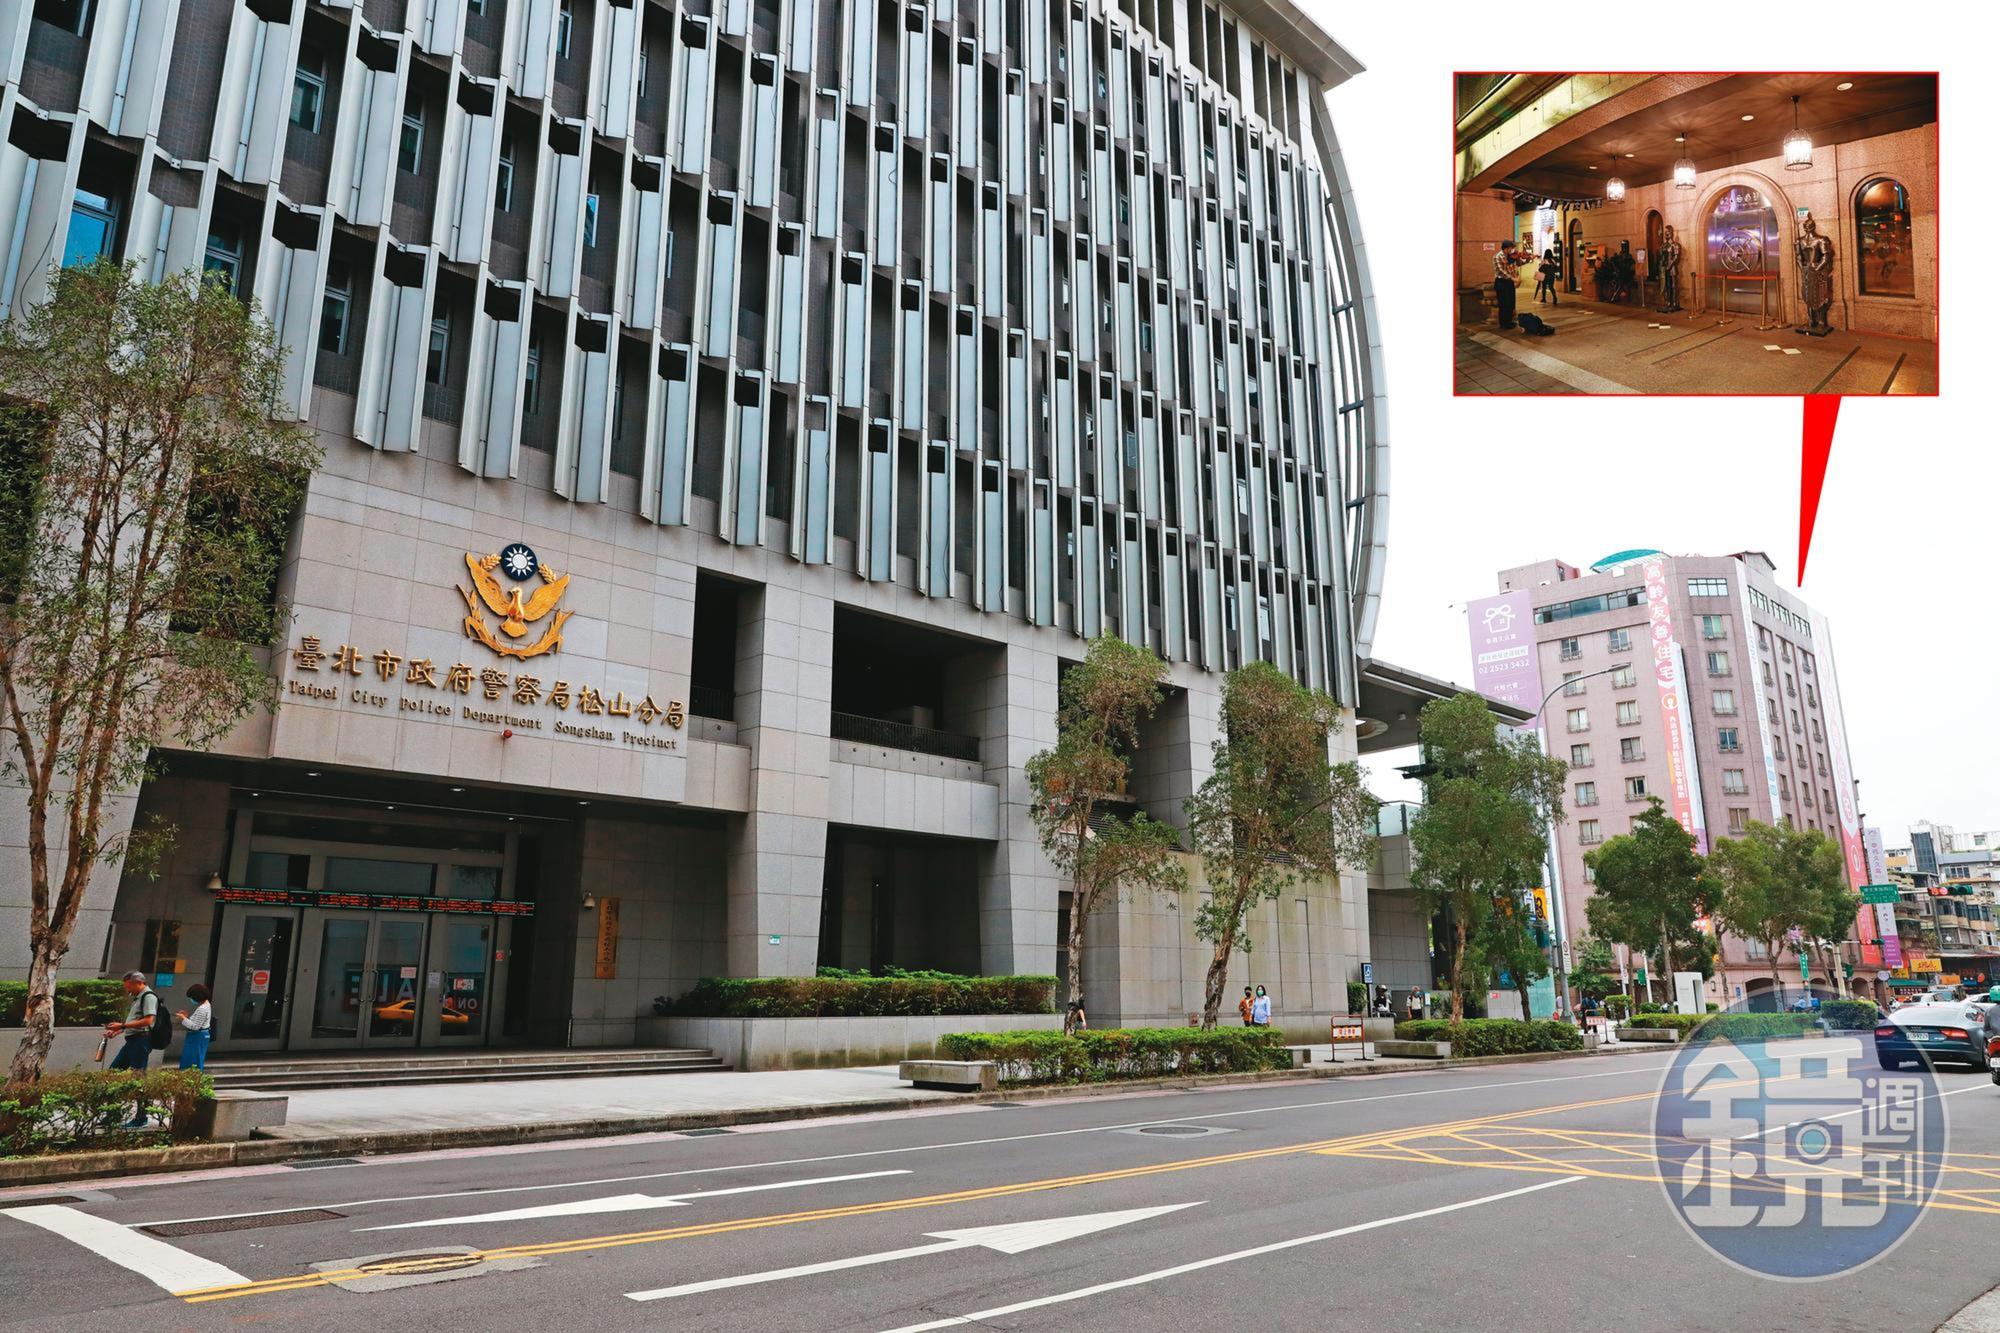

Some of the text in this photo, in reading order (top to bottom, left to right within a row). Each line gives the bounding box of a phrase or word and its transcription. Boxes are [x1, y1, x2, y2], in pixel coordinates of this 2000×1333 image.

[288, 678, 678, 750] Taipei City Police Department Songshan Precinct
[293, 634, 687, 730] 臺北市政府警察局松山分局
